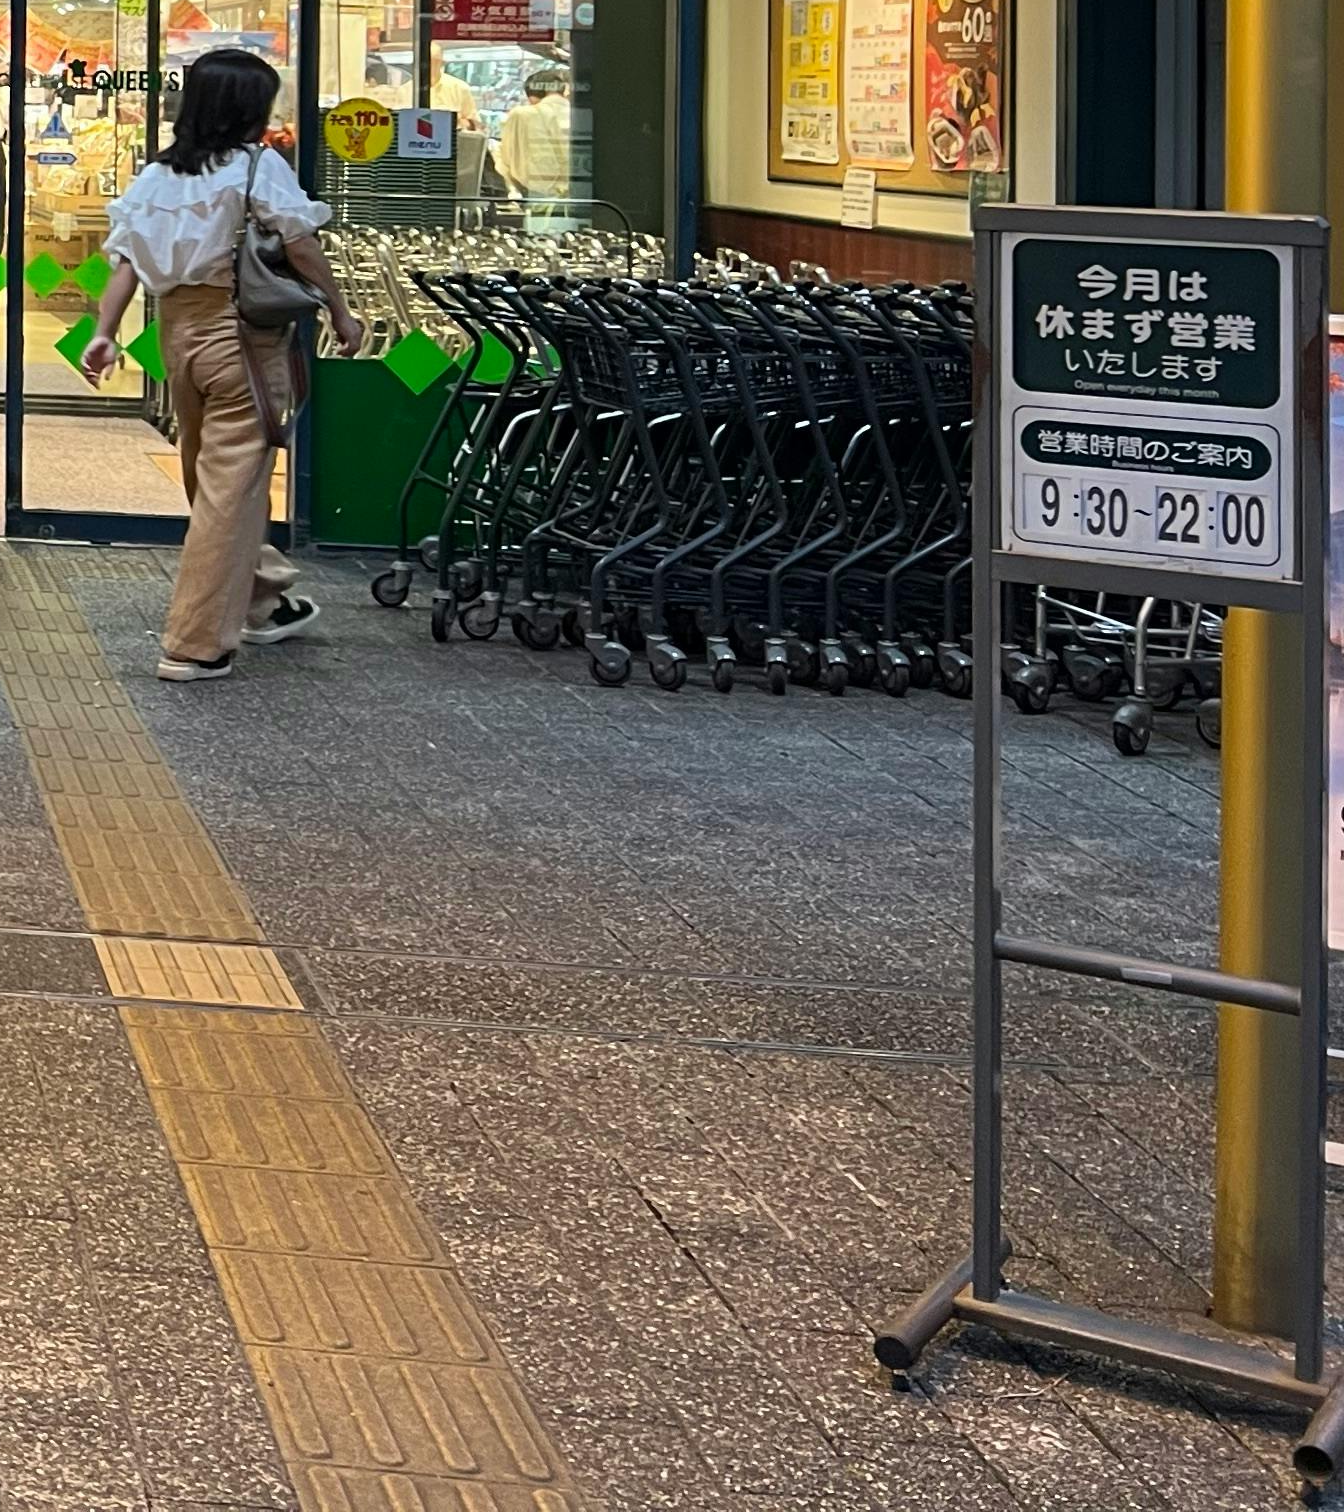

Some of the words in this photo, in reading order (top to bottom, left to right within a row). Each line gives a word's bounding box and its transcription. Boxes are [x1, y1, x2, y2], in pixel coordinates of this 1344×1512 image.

[408, 141, 442, 150] menu
[1077, 264, 1209, 303] 今月は
[1035, 304, 1257, 352] 休まず営業
[1064, 348, 1224, 383] いたします
[1074, 379, 1105, 392] Open
[1107, 383, 1157, 397] everyday
[1158, 386, 1181, 398] this
[1182, 389, 1220, 400] month
[1037, 428, 1254, 469] 営業時間のご案内
